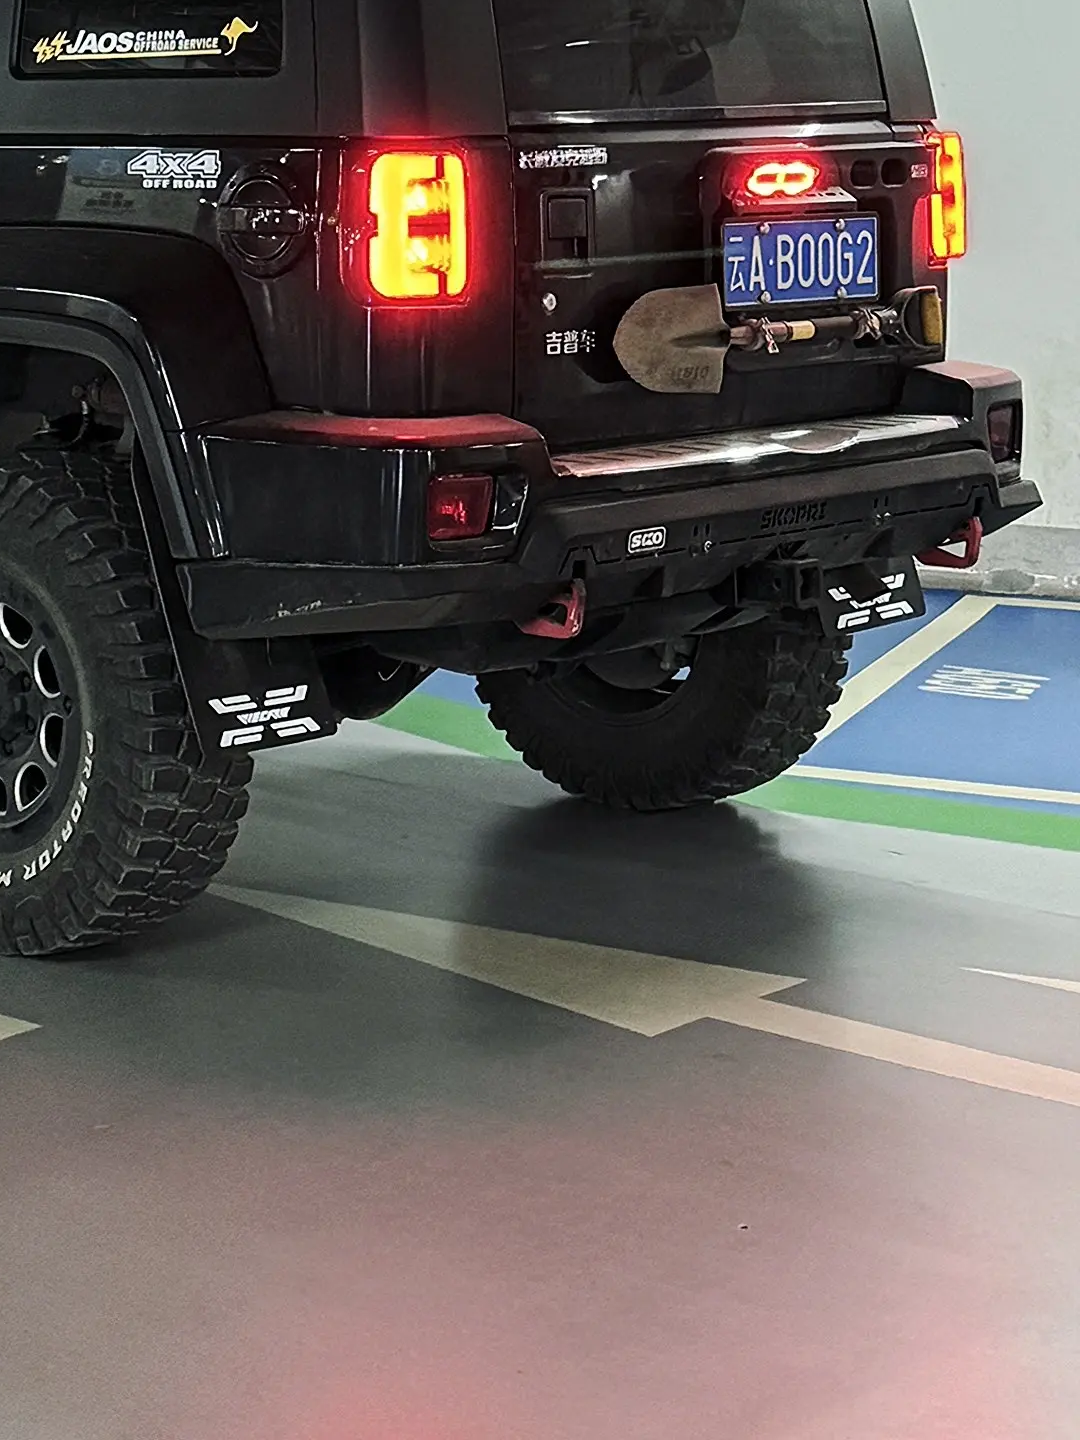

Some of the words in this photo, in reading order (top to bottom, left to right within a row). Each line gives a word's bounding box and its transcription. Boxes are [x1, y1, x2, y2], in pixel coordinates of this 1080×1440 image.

[65, 29, 135, 54] JAOS
[177, 37, 219, 51] SERVICE
[135, 29, 186, 42] CHINA
[142, 179, 170, 189] OFF
[172, 179, 217, 189] ROAD
[545, 329, 596, 355] 吉普车
[630, 531, 663, 549] SKO
[22, 730, 95, 880] PREDATOR
